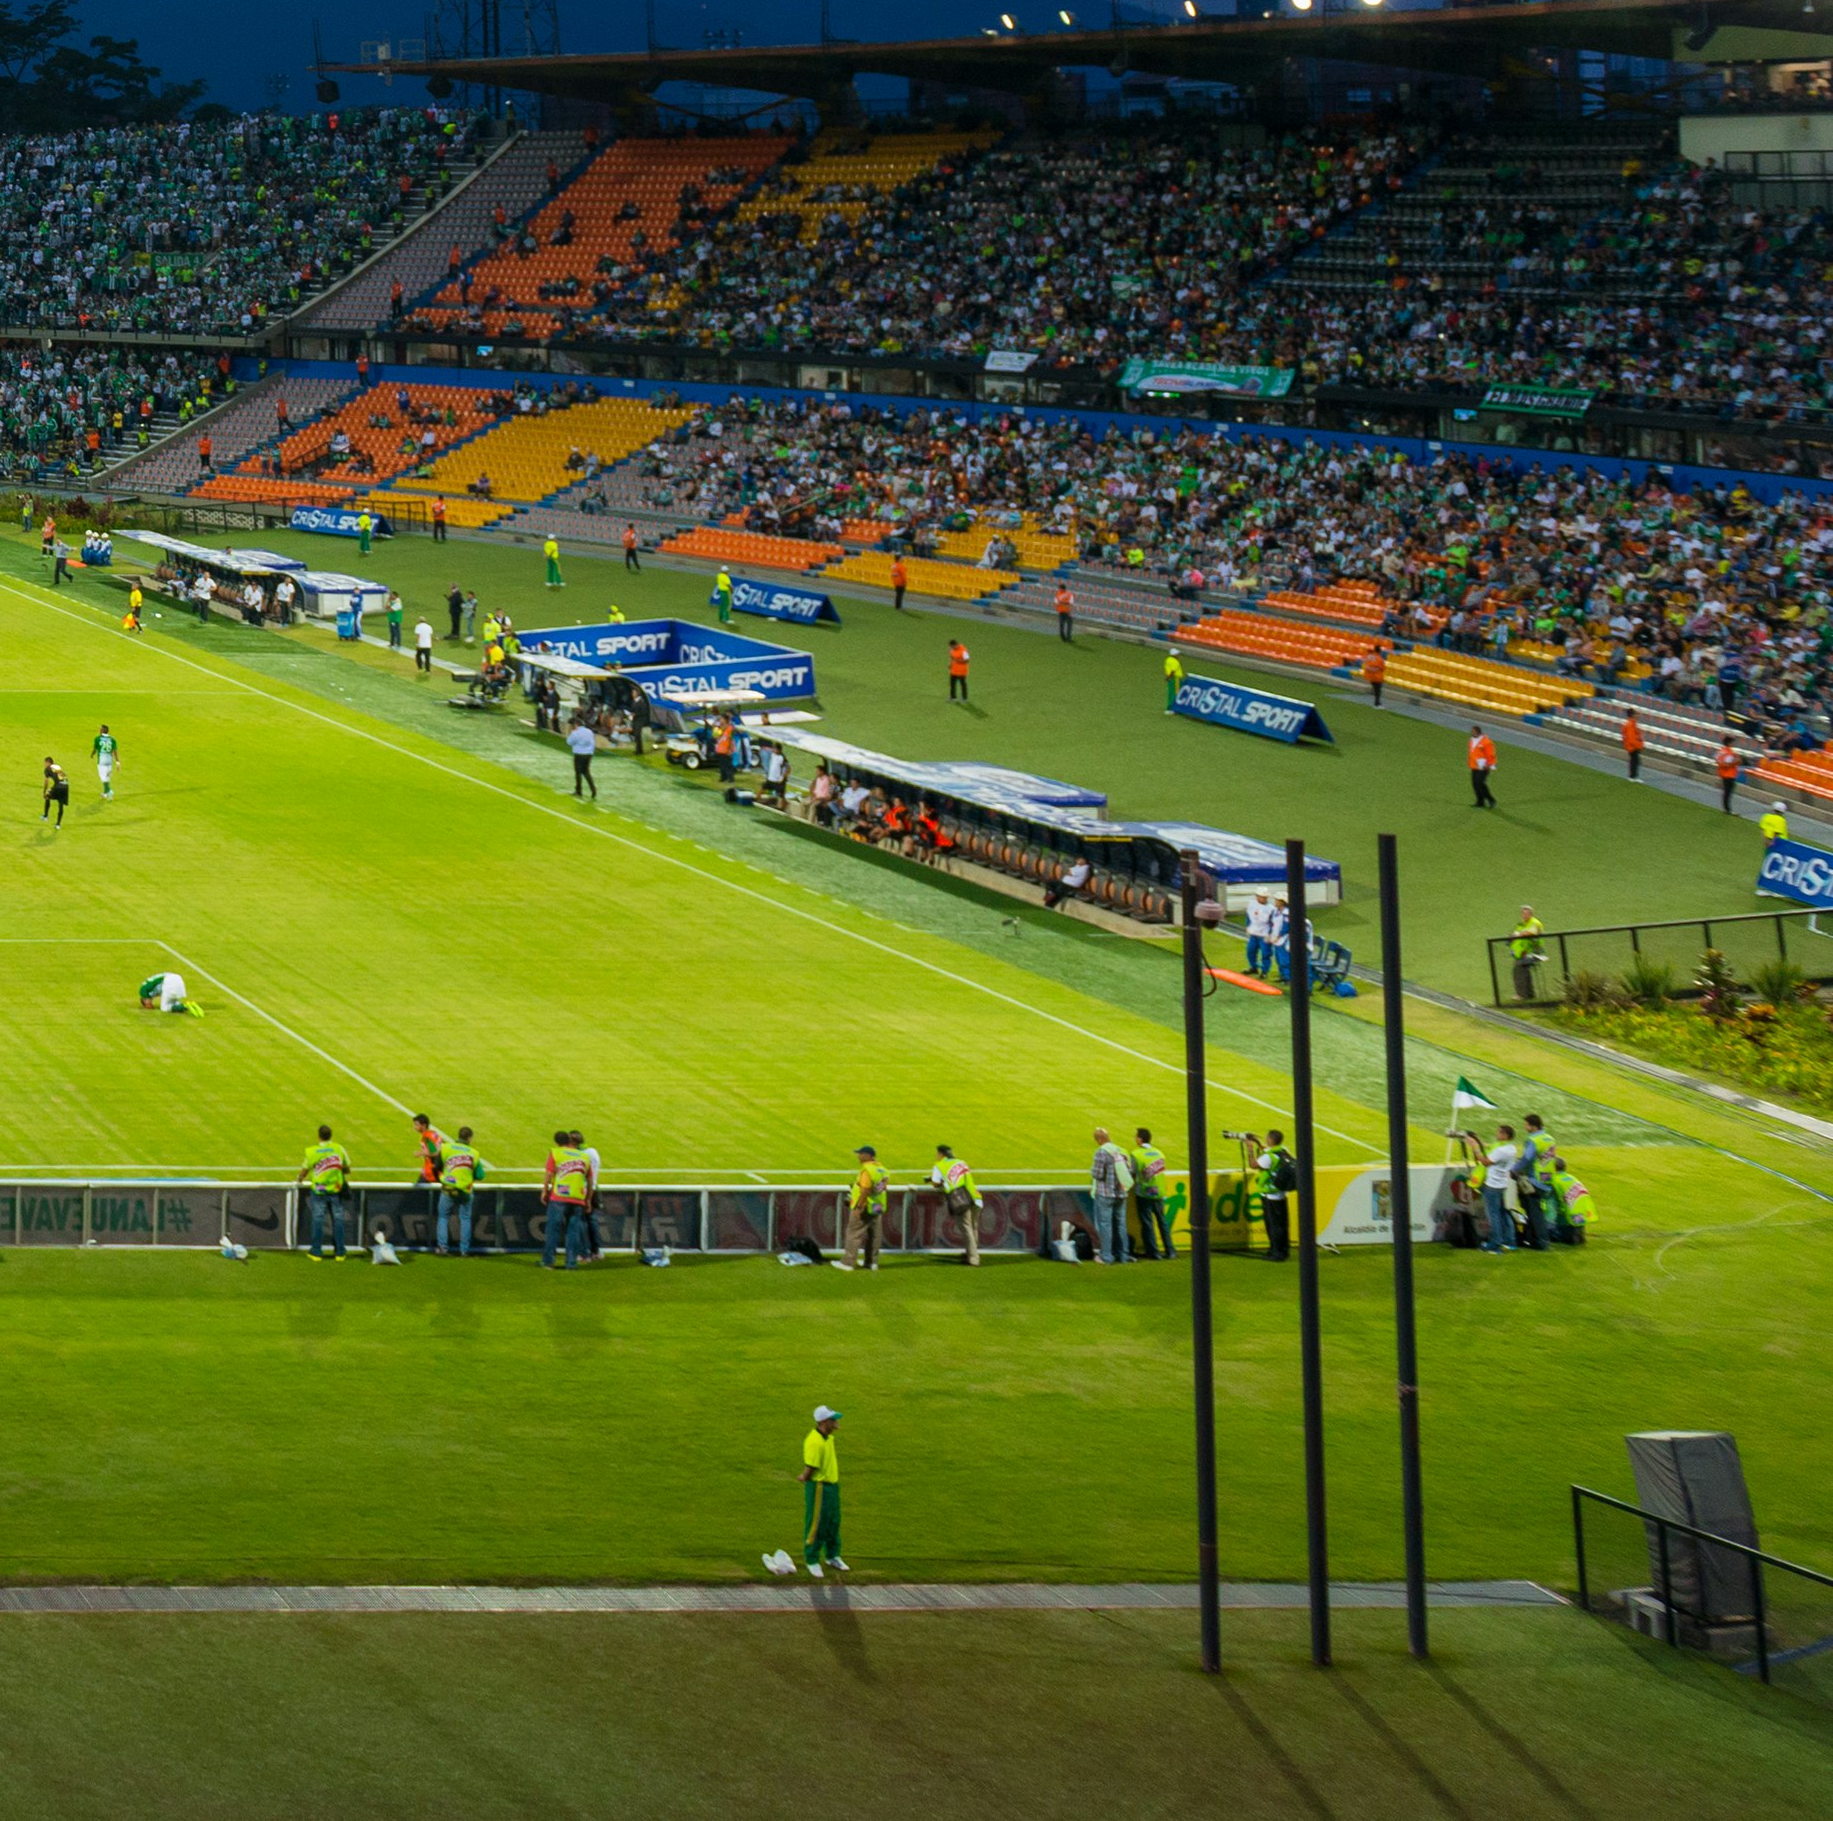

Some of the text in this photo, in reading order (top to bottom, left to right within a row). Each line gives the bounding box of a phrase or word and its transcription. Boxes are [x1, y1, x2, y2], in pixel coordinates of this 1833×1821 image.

[155, 255, 190, 267] SALIDA
[291, 510, 379, 539] CRISTAL SPOT
[768, 593, 823, 617] SPORT
[595, 631, 671, 656] SPORT
[642, 666, 808, 700] RISTAL SPORT
[1175, 685, 1306, 733] CRISTAL SPORT
[99, 741, 112, 753] 26
